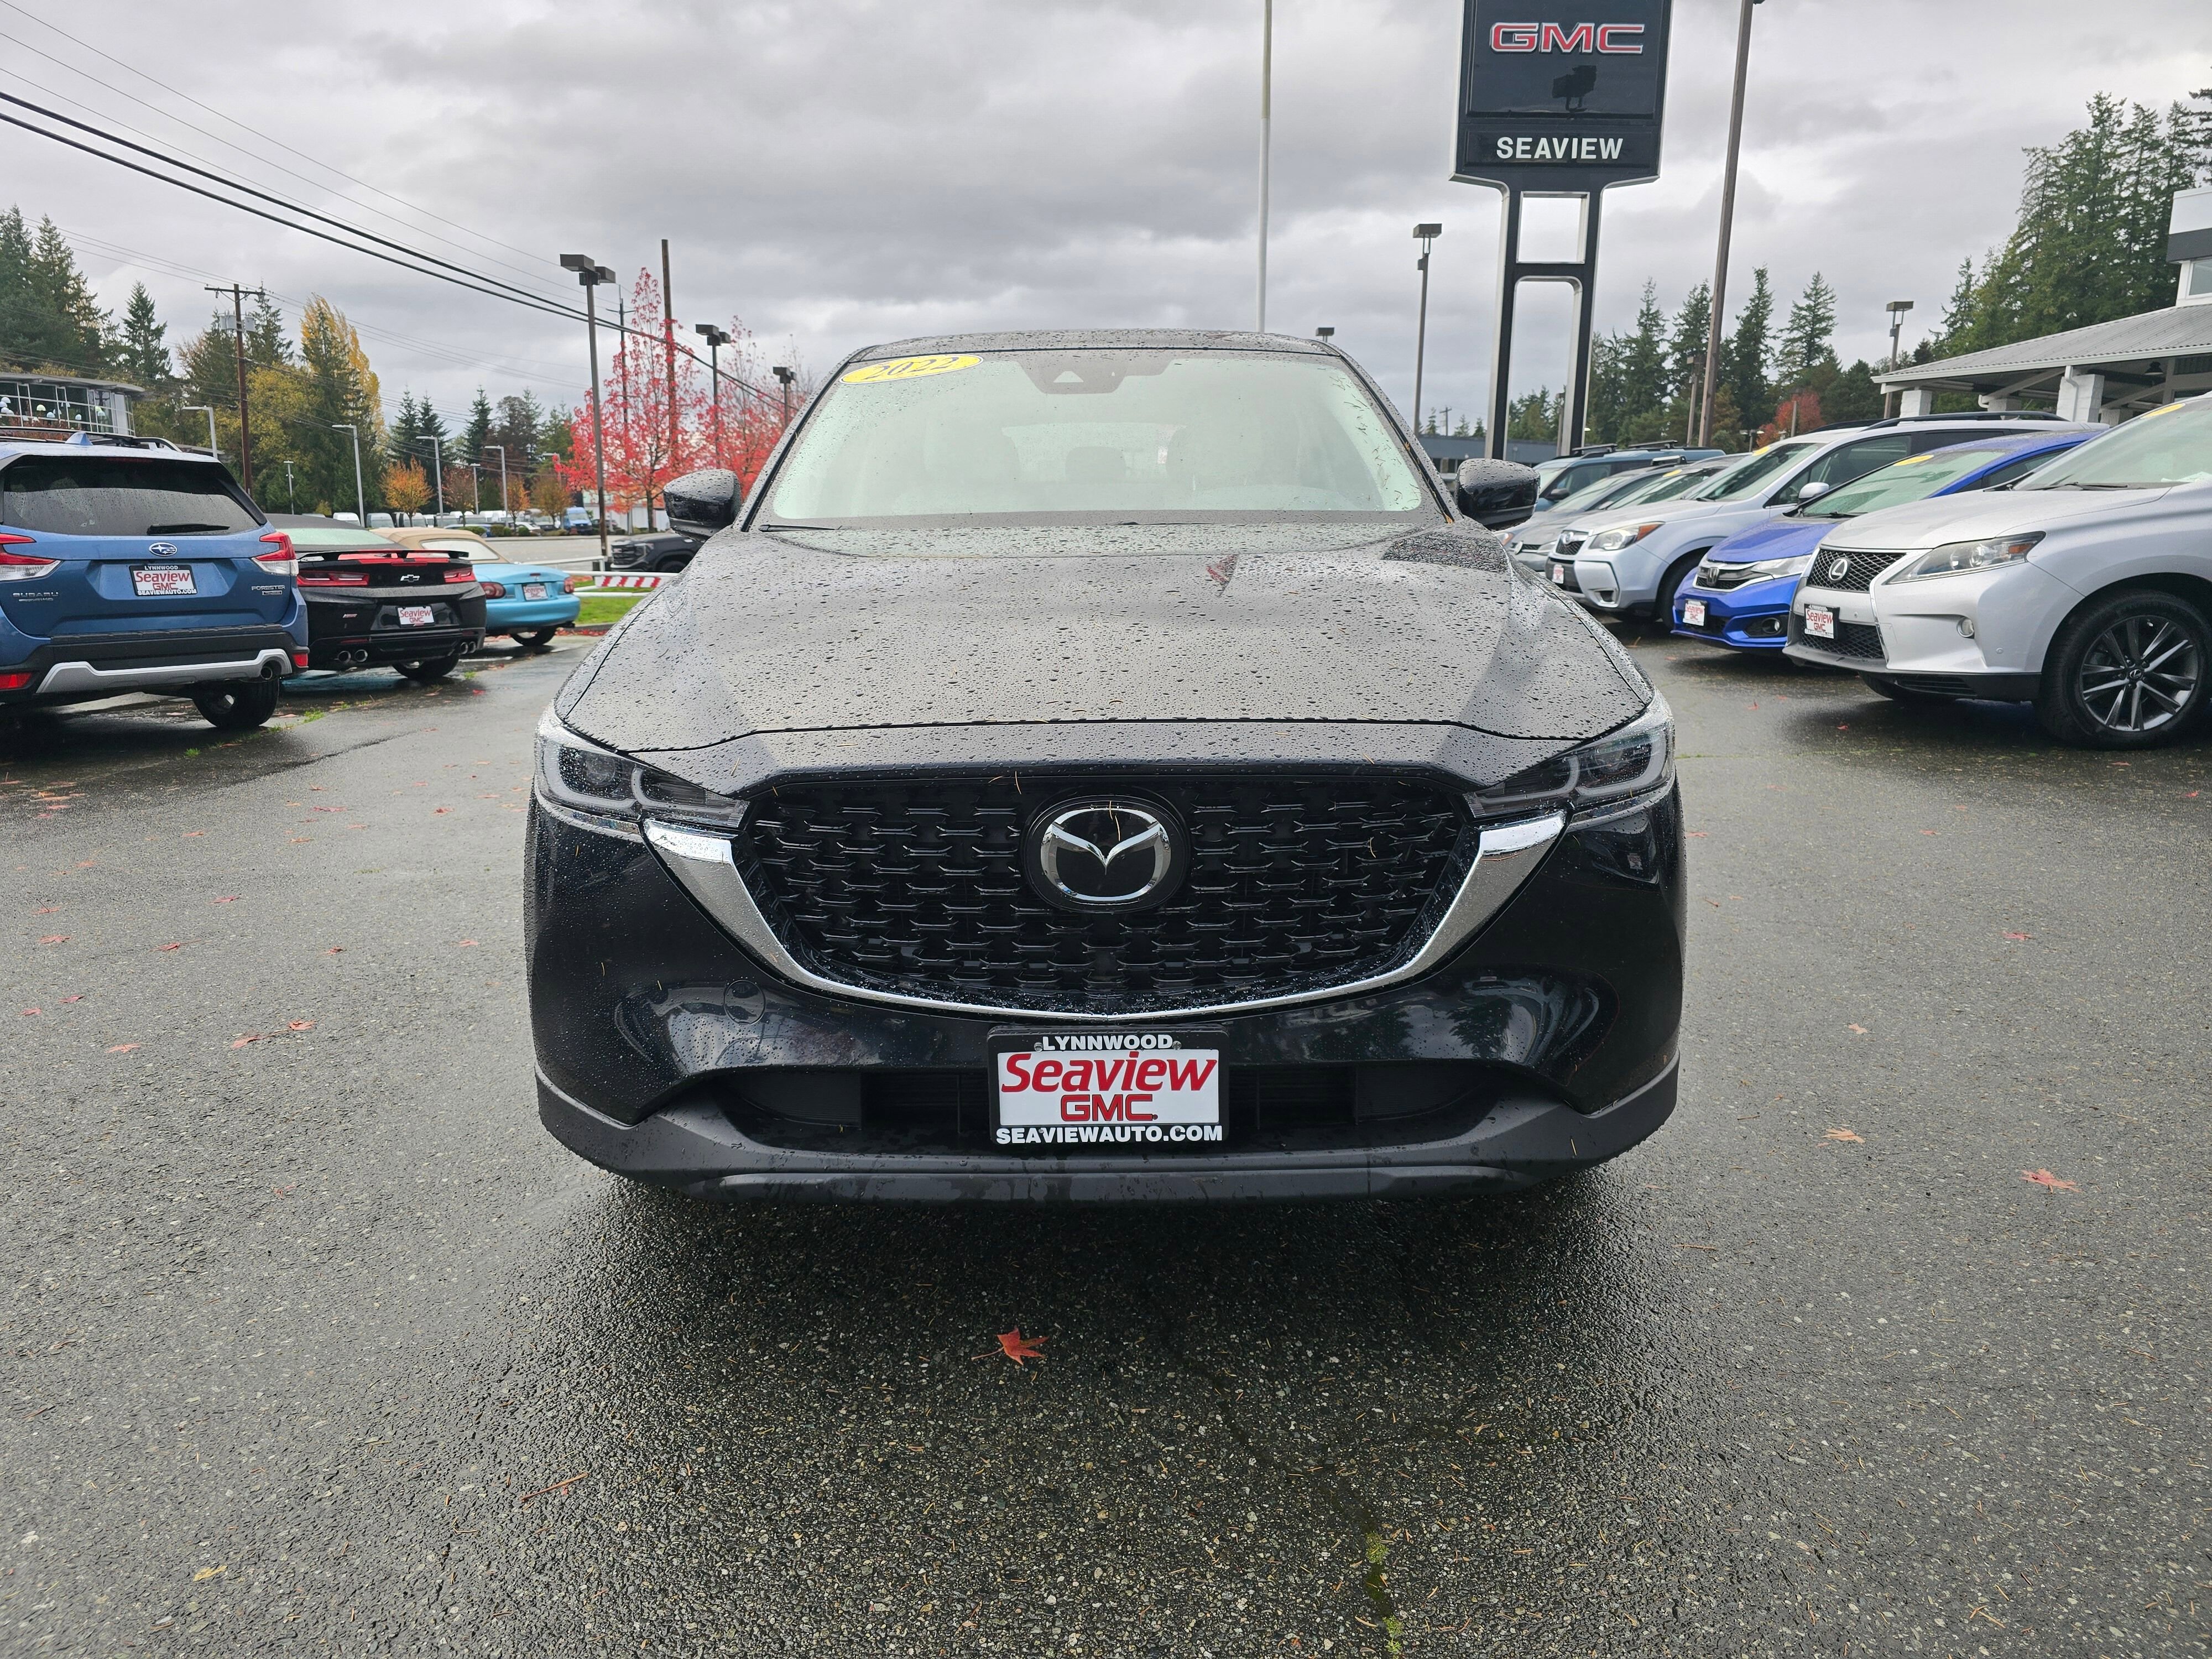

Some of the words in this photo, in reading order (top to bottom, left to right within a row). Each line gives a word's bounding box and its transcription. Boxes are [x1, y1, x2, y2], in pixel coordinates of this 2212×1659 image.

[1491, 22, 1645, 54] GMC
[1496, 137, 1624, 159] SEAVIEW
[860, 357, 959, 380] 2022
[135, 571, 190, 583] Seaview
[153, 582, 179, 591] GMC
[400, 609, 431, 618] Seaview
[1807, 609, 1832, 624] Seaview
[1813, 622, 1826, 632] GMC
[1042, 1035, 1173, 1051] LYNNWOOD
[1001, 1051, 1217, 1092] Seaview
[1061, 1094, 1154, 1121] GMC
[996, 1125, 1223, 1144] SEAVIEWAUTO.COM
